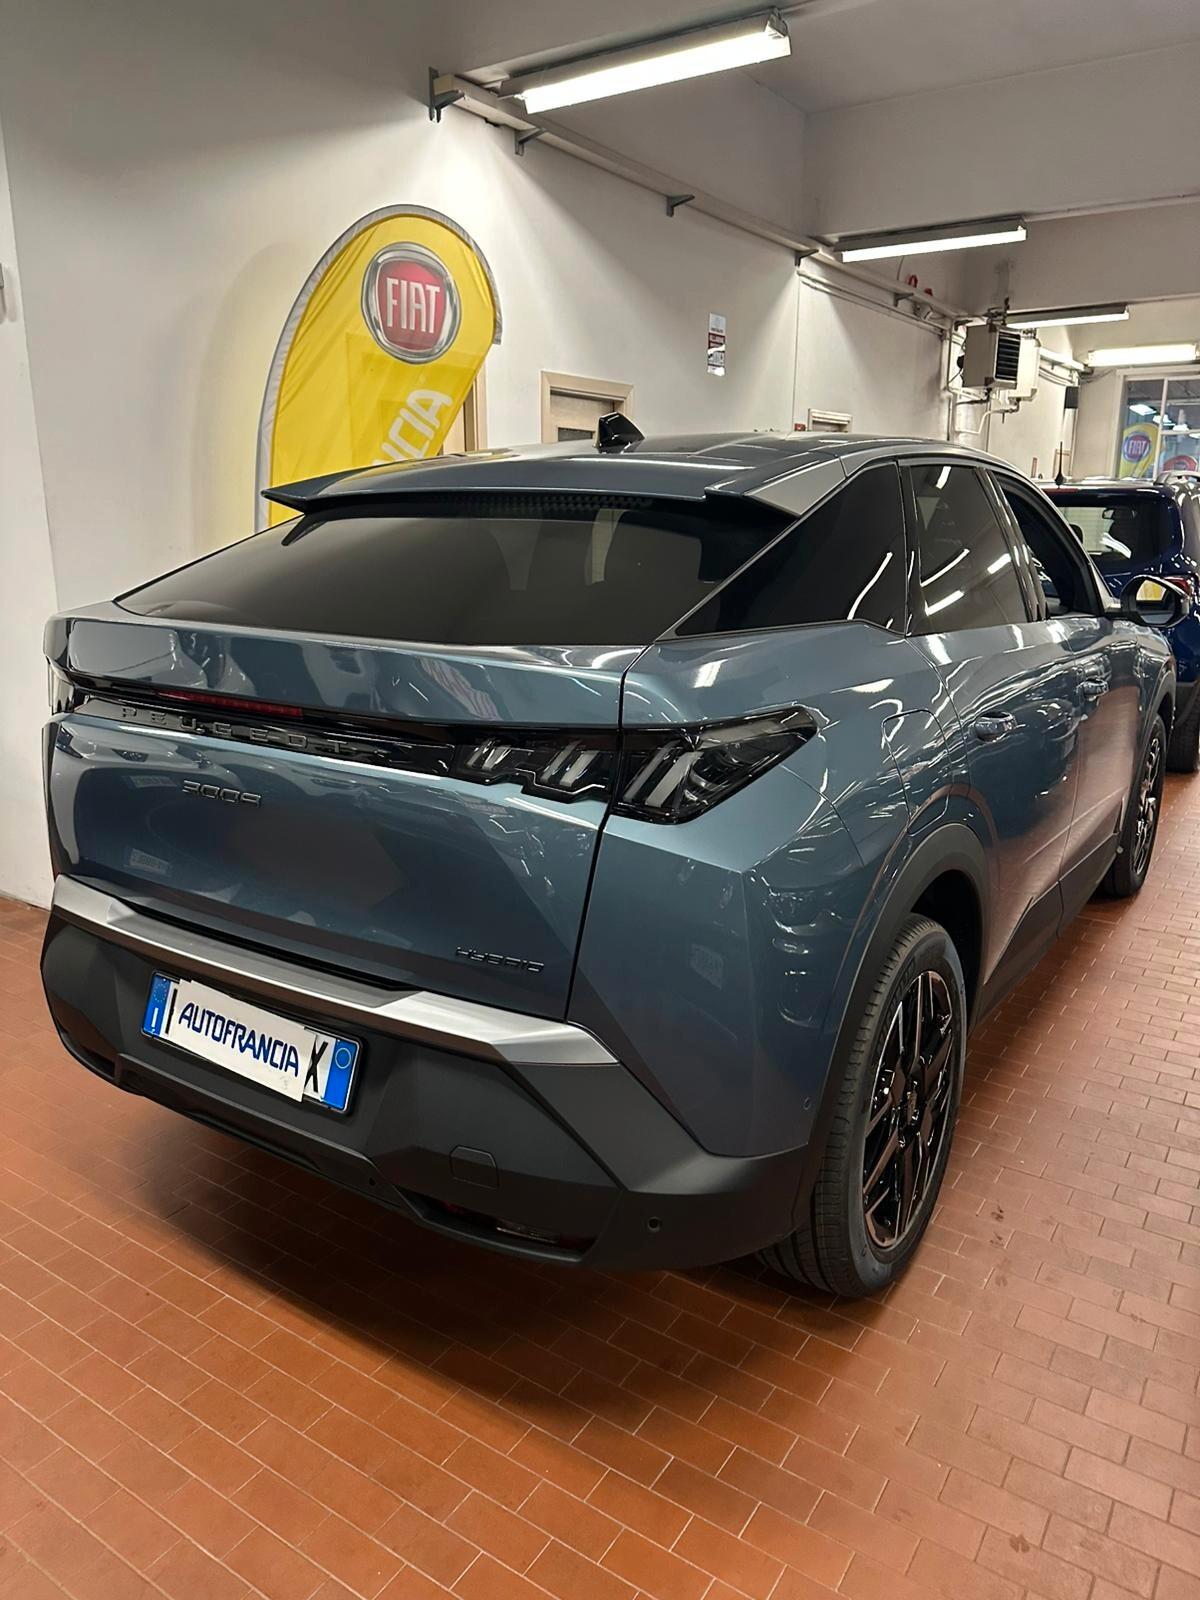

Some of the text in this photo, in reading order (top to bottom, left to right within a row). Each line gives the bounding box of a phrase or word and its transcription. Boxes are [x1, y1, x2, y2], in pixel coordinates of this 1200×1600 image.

[386, 277, 440, 334] FIAT
[1128, 439, 1147, 455] FIAT
[121, 706, 348, 754] PEUGEOT
[178, 1001, 300, 1078] AUTOFRANCIA
